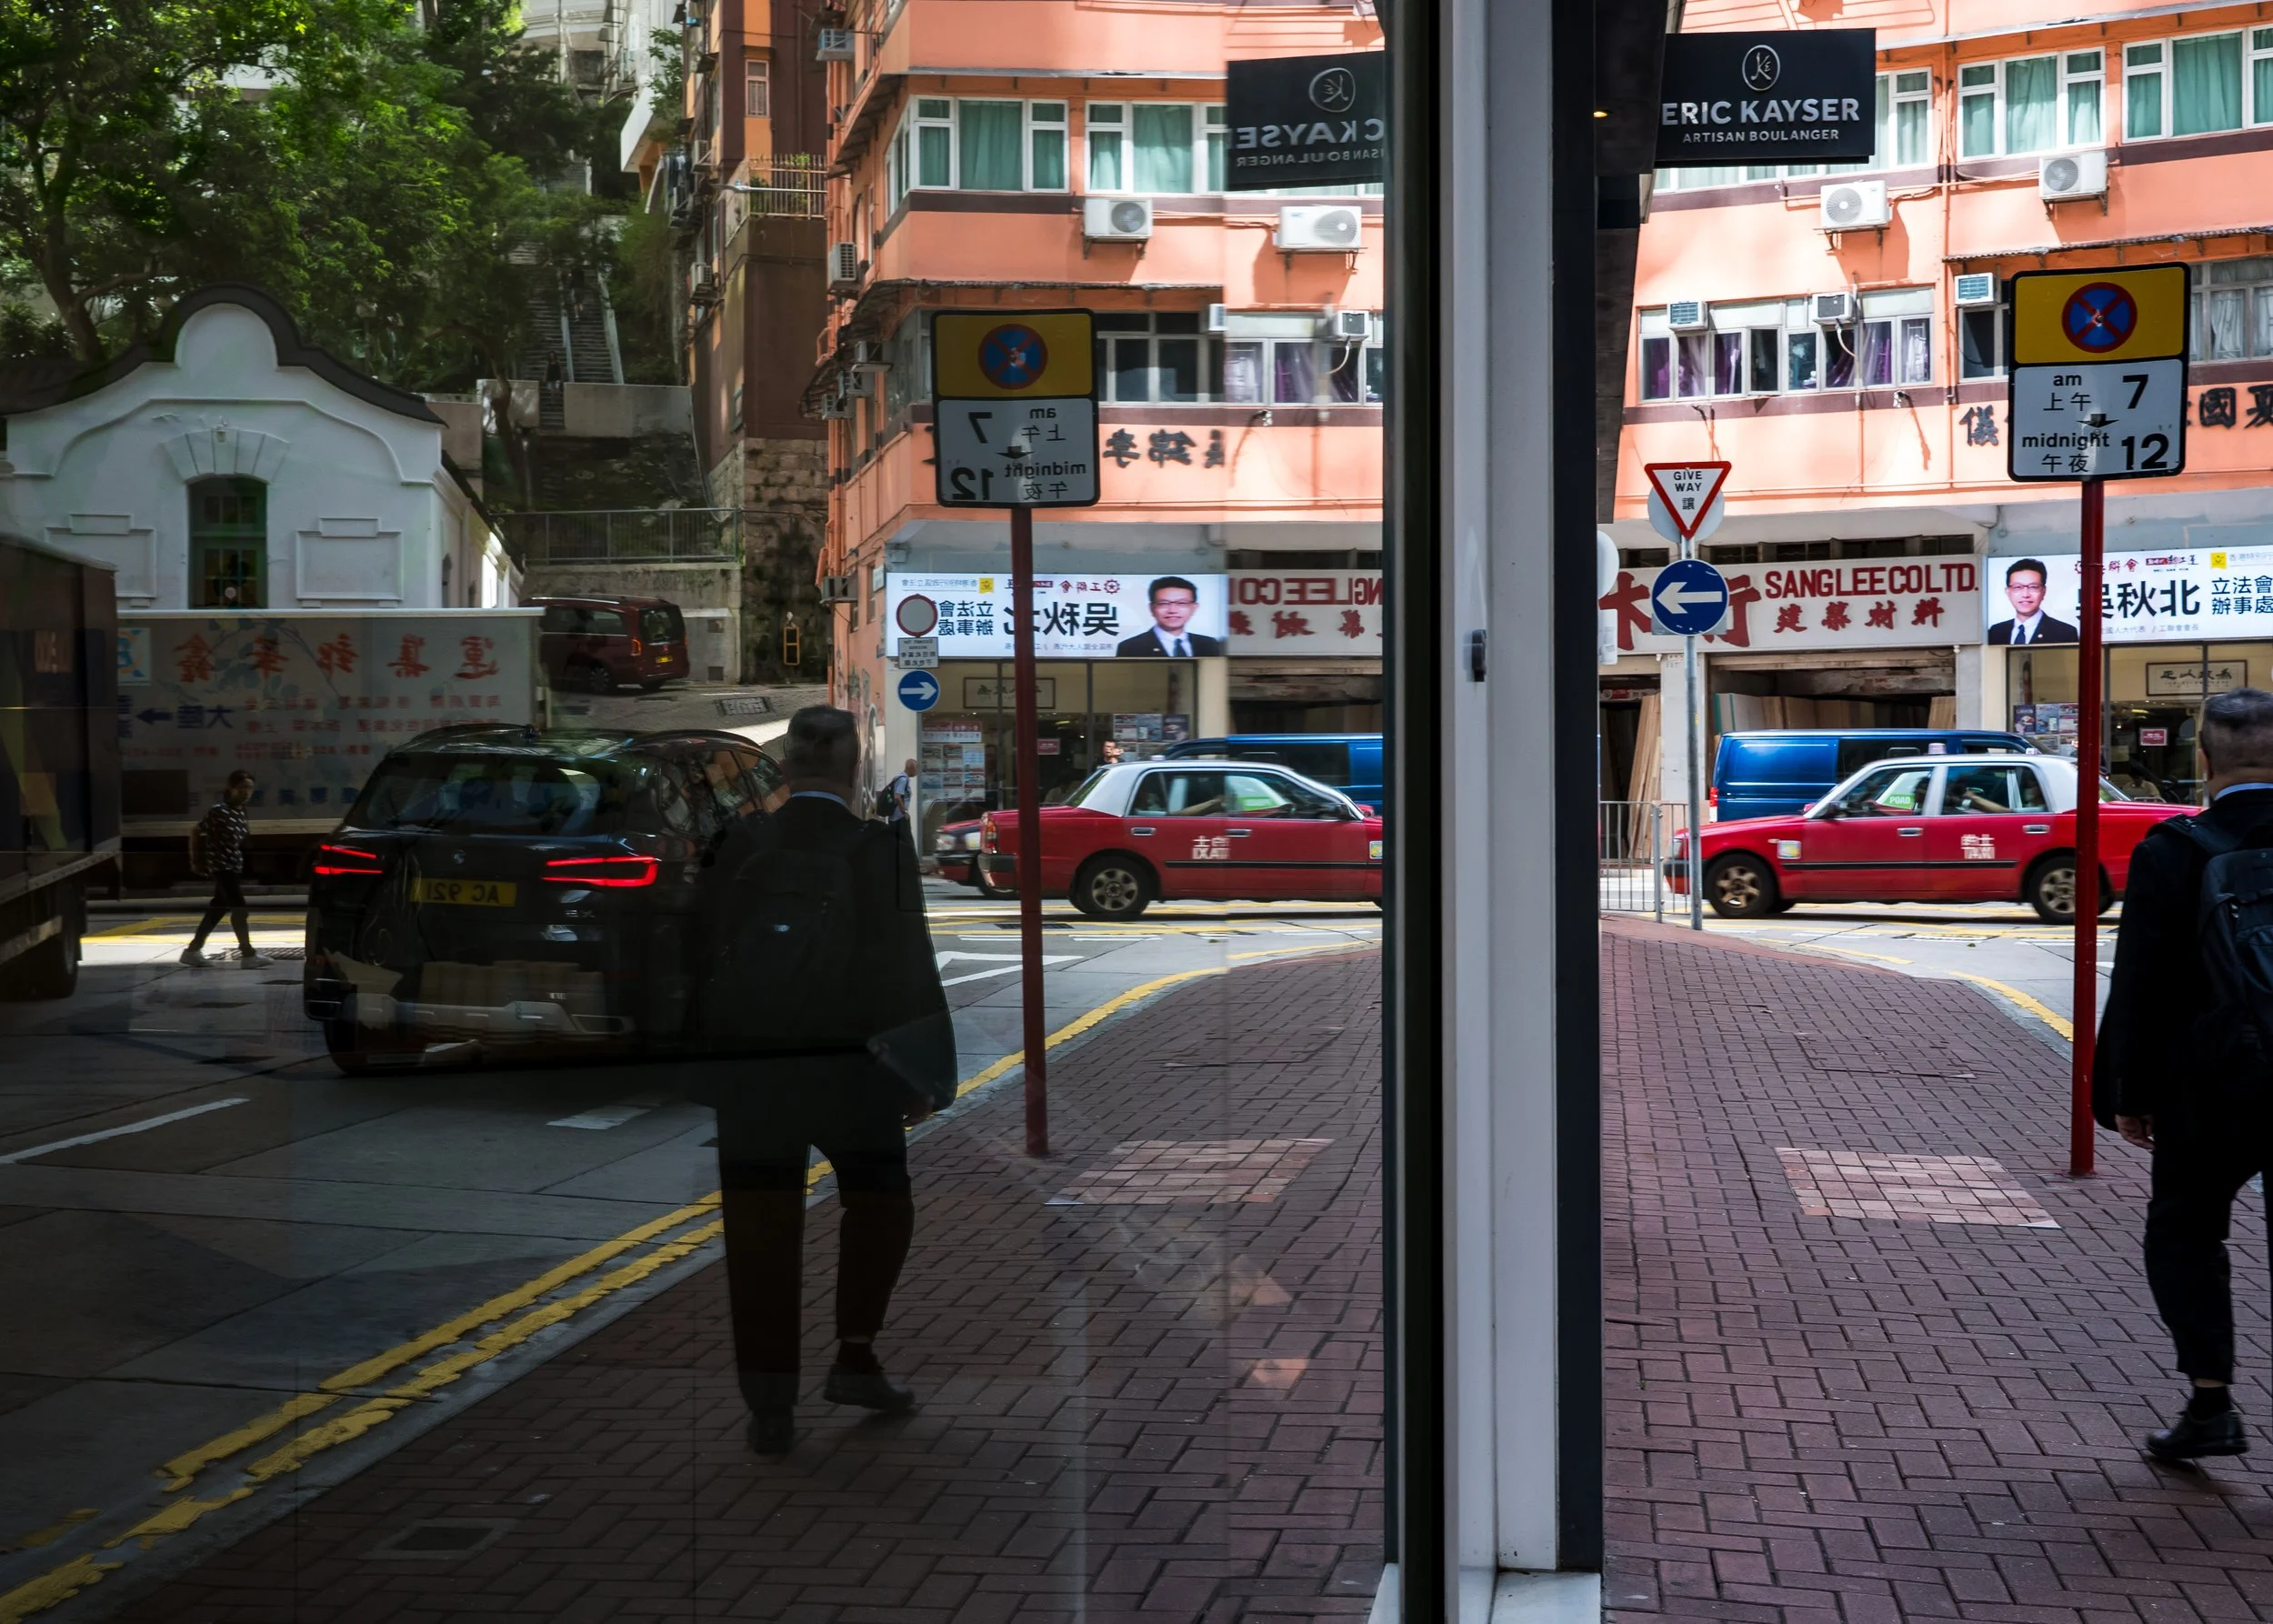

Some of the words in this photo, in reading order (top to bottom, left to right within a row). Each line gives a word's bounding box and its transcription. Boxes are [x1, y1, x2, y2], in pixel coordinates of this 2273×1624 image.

[1662, 101, 1732, 125] ERIC
[1740, 98, 1860, 124] KAYSER
[1682, 131, 1746, 144] ARTISAN
[1749, 129, 1839, 142] BOULANGER
[2053, 375, 2082, 386] am
[2122, 374, 2149, 409] 7
[2043, 393, 2092, 412] 上午
[2022, 431, 2110, 450] midnight
[2121, 433, 2169, 471] 12
[2041, 454, 2089, 473] 午夜
[1673, 471, 1703, 481] GIVE
[1674, 482, 1703, 492] WAY
